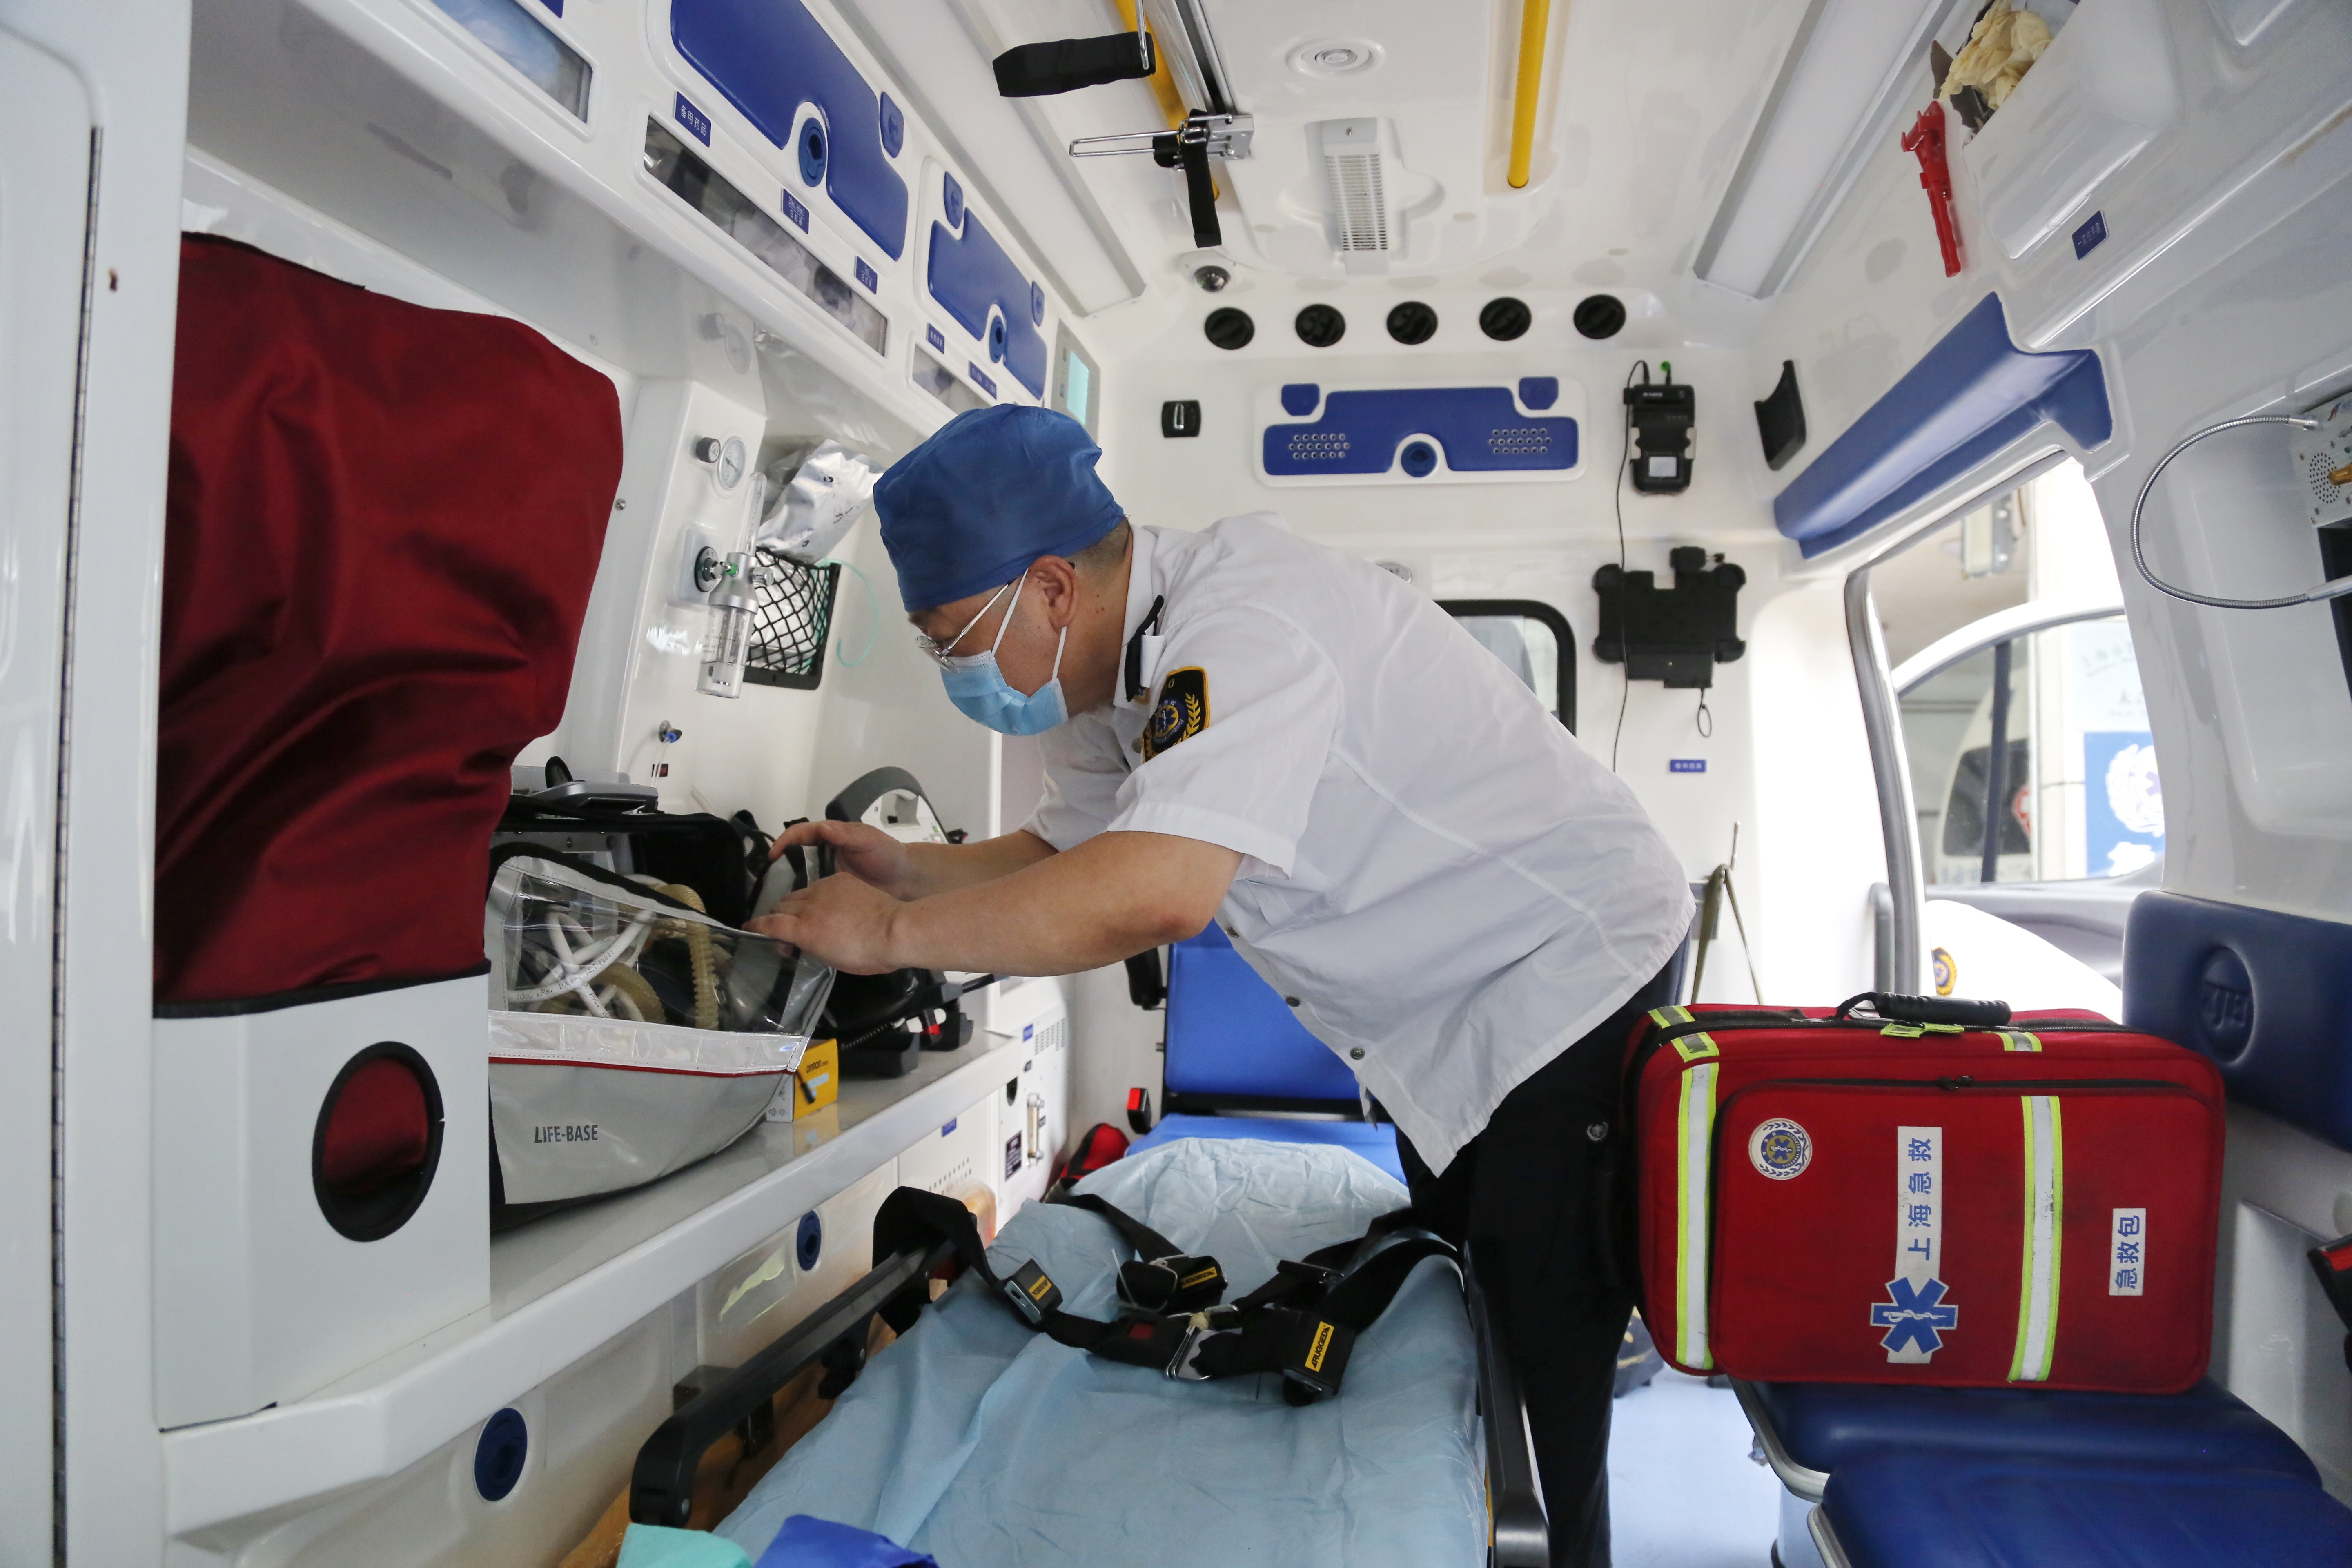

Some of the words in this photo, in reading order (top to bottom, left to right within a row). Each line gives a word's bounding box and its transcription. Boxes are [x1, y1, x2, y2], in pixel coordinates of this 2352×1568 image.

[681, 105, 706, 136] 备用药品
[534, 1125, 598, 1143] LIFE-BASE
[1907, 1138, 1931, 1261] 上海急救
[2115, 1215, 2140, 1289] 急救包
[1311, 1329, 1329, 1365] RUGGED
